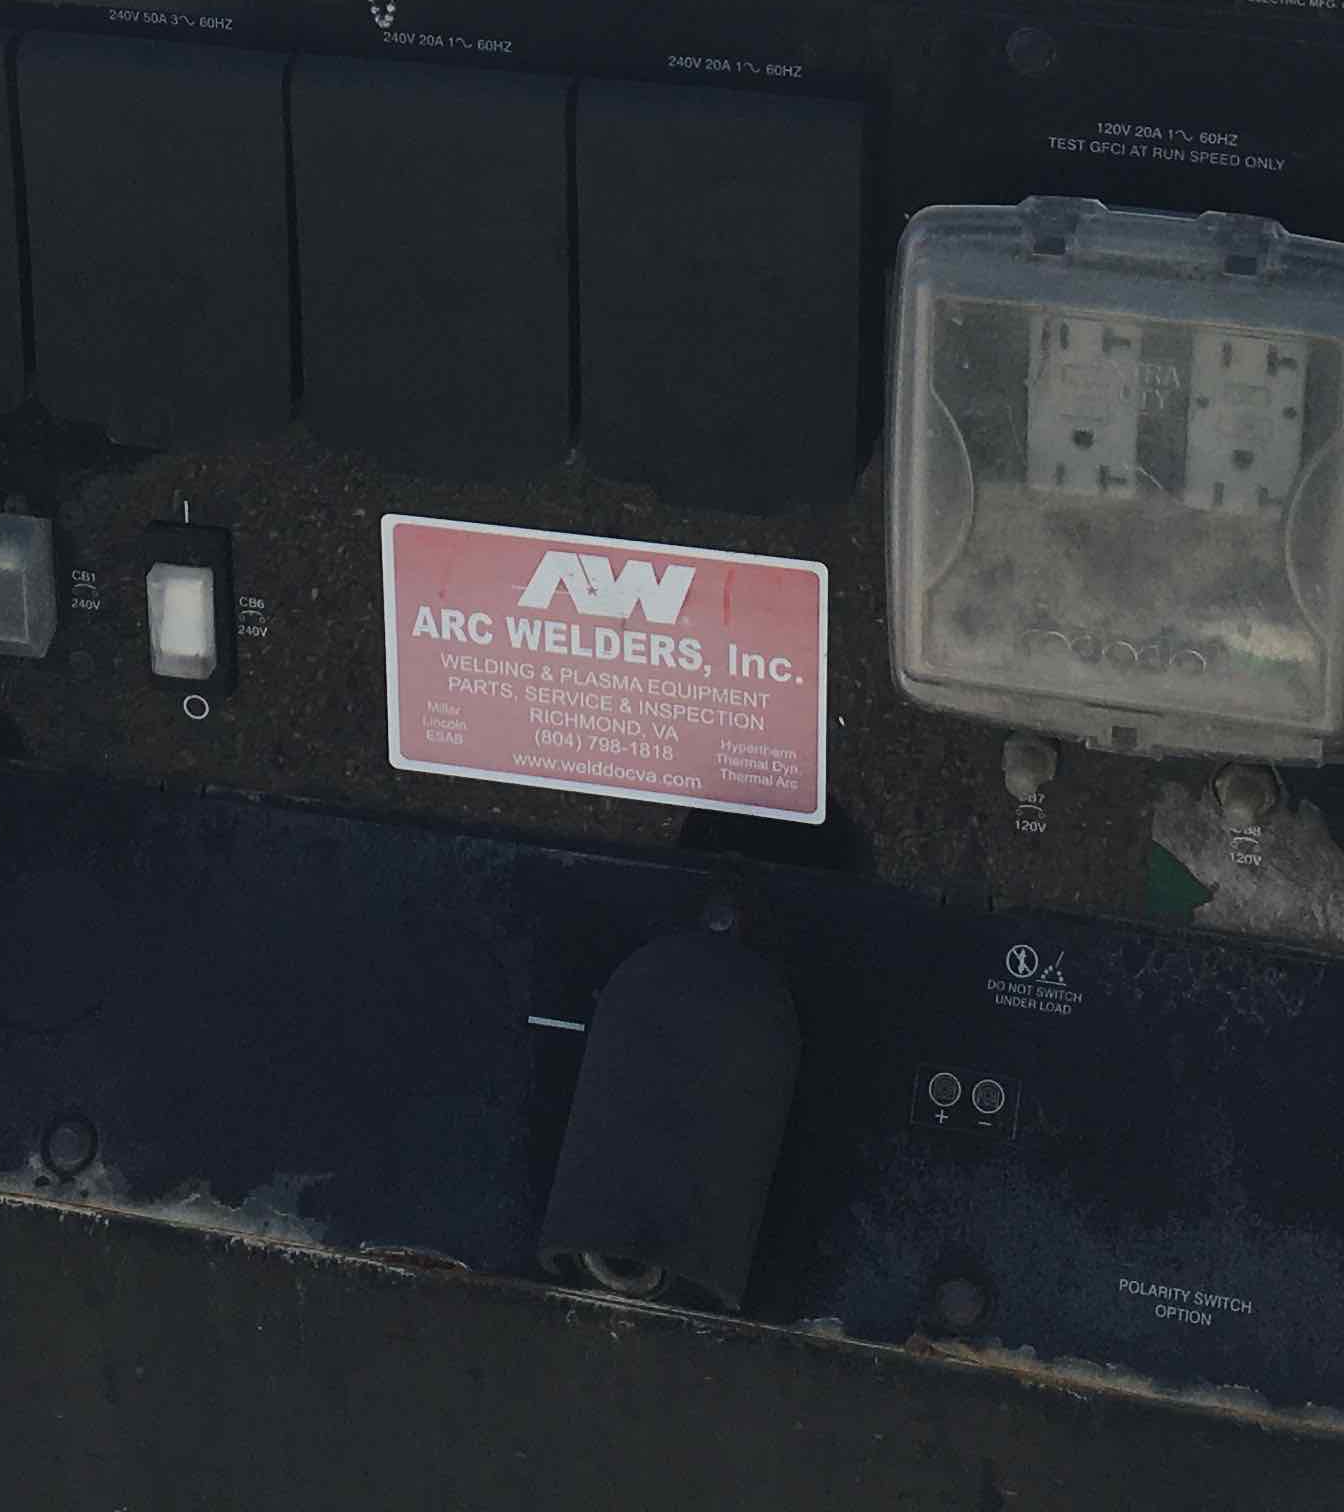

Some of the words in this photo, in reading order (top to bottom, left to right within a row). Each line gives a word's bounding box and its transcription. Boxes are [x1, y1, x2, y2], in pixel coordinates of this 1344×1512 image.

[109, 9, 140, 22] 240V
[143, 11, 168, 24] 50A
[199, 16, 233, 30] 60HZ
[383, 31, 416, 45] 240V
[418, 33, 444, 48] 20A
[477, 39, 512, 53] 60HZ
[667, 55, 702, 70] 240V
[705, 58, 731, 72] 20A
[765, 63, 803, 78] 60HZ
[1097, 122, 1131, 137] 120V
[1135, 125, 1162, 140] 20A
[1199, 132, 1239, 147] 60HZ
[1048, 137, 1085, 152] TEST
[1089, 140, 1126, 156] GFCI
[1129, 144, 1149, 158] AT
[1152, 147, 1186, 162] RUN
[1190, 150, 1240, 168] SPEED
[1245, 155, 1286, 172] ONLY
[71, 569, 96, 583] CB1
[71, 598, 101, 611] 240V
[237, 624, 268, 637] 240V
[412, 605, 494, 646] ARC
[506, 615, 713, 679] WELDERS,
[727, 643, 804, 685] Inc.
[440, 652, 535, 680] WELDING
[540, 665, 554, 681] &
[559, 667, 643, 694] PLASMA
[648, 679, 771, 709] EQUIPMENT
[447, 676, 519, 703] PARTS,
[525, 686, 613, 713] SERVICE
[619, 697, 632, 714] &
[639, 700, 765, 731] INSPECTION
[529, 707, 646, 739] RICHMOND,
[651, 723, 679, 742] VA
[535, 728, 583, 752] (804)
[589, 734, 674, 761] 798-1818
[1015, 820, 1047, 833] 120V
[1230, 852, 1262, 866] 120V
[987, 978, 1006, 991] DO
[1008, 982, 1033, 996] NOT
[1036, 986, 1083, 1004] SWITCH
[995, 994, 1036, 1009] UNDER
[1039, 1001, 1073, 1015] LOAD
[1119, 1278, 1190, 1304] POLARITY
[1194, 1290, 1253, 1315] SWITCH
[1155, 1304, 1213, 1328] OPTION
